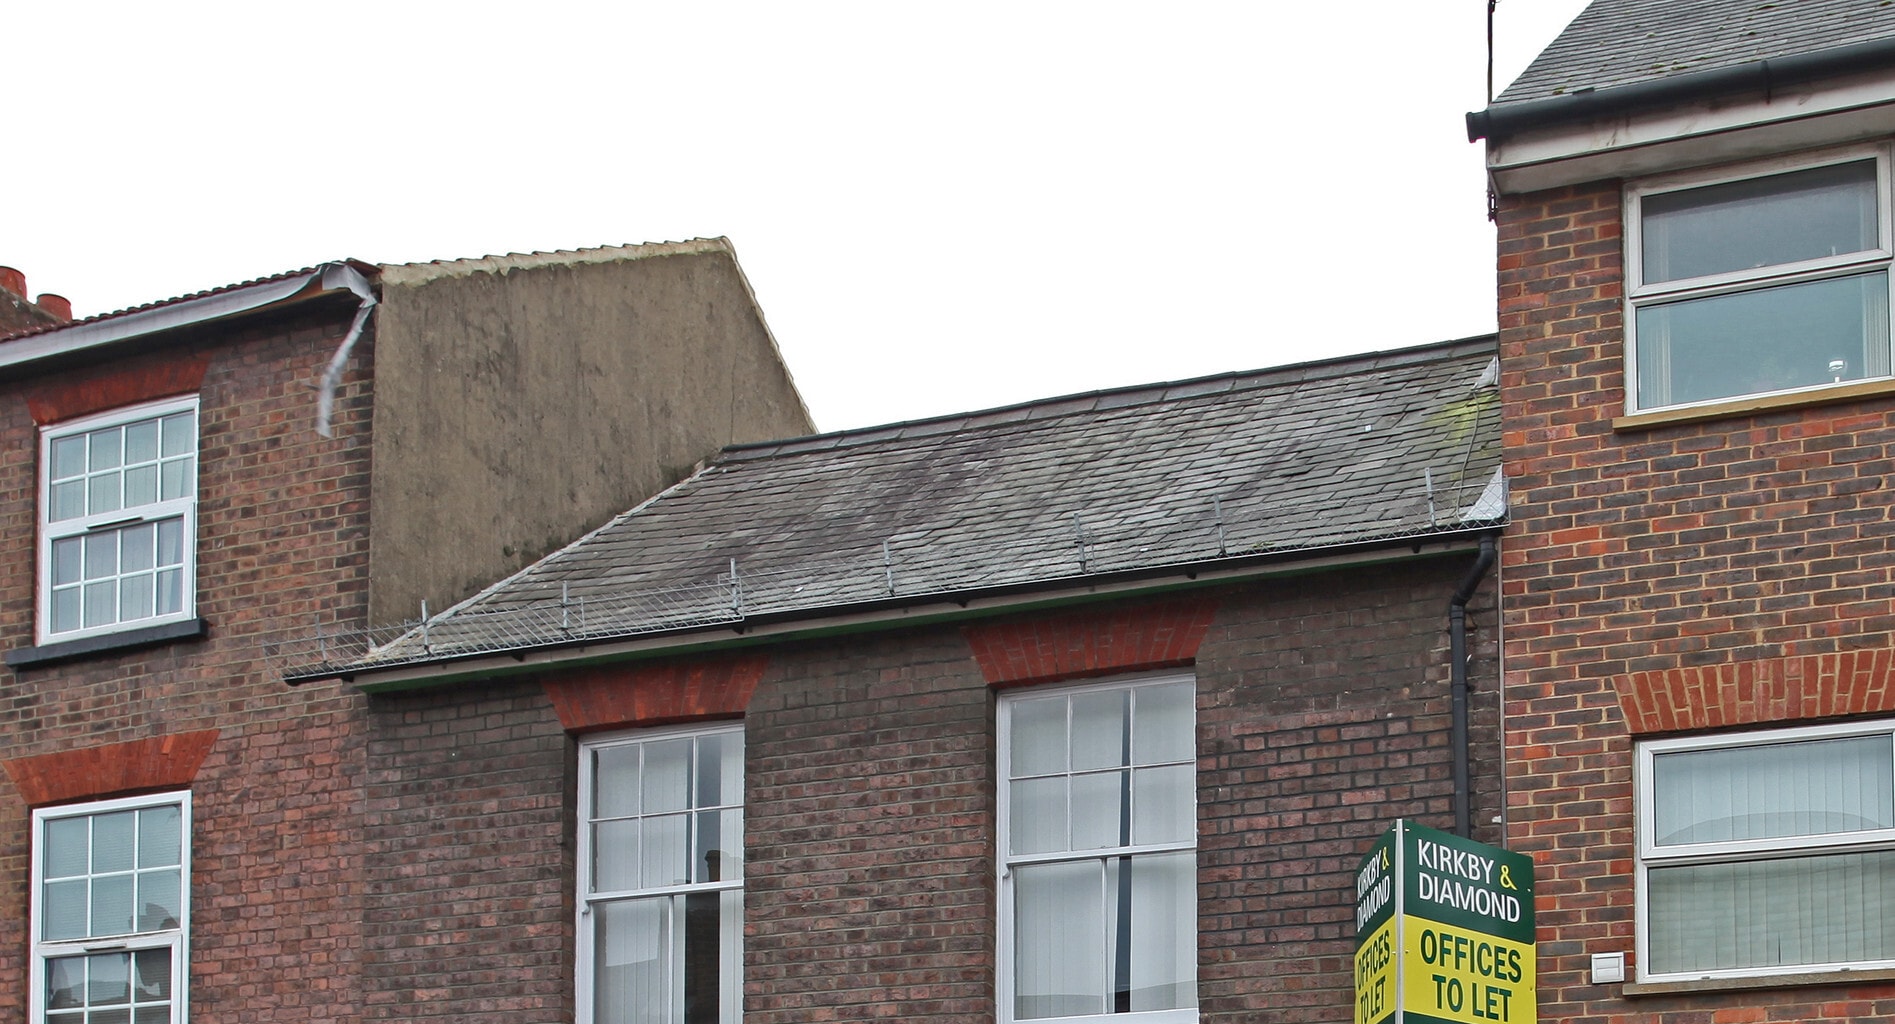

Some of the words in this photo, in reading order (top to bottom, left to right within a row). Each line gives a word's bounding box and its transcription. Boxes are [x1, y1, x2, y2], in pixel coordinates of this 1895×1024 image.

[1357, 849, 1381, 902] KIRKBY
[1382, 846, 1390, 871] &
[1418, 839, 1494, 884] KIRKBY
[1500, 864, 1517, 890] &
[1357, 875, 1390, 933] DIAMOND
[1419, 871, 1520, 923] DIAMOND
[1357, 929, 1390, 991] OFFICES
[1420, 929, 1522, 983] OFFICES
[1371, 975, 1386, 1019] LET
[1432, 974, 1463, 1013] TO
[1472, 983, 1512, 1022] LET
